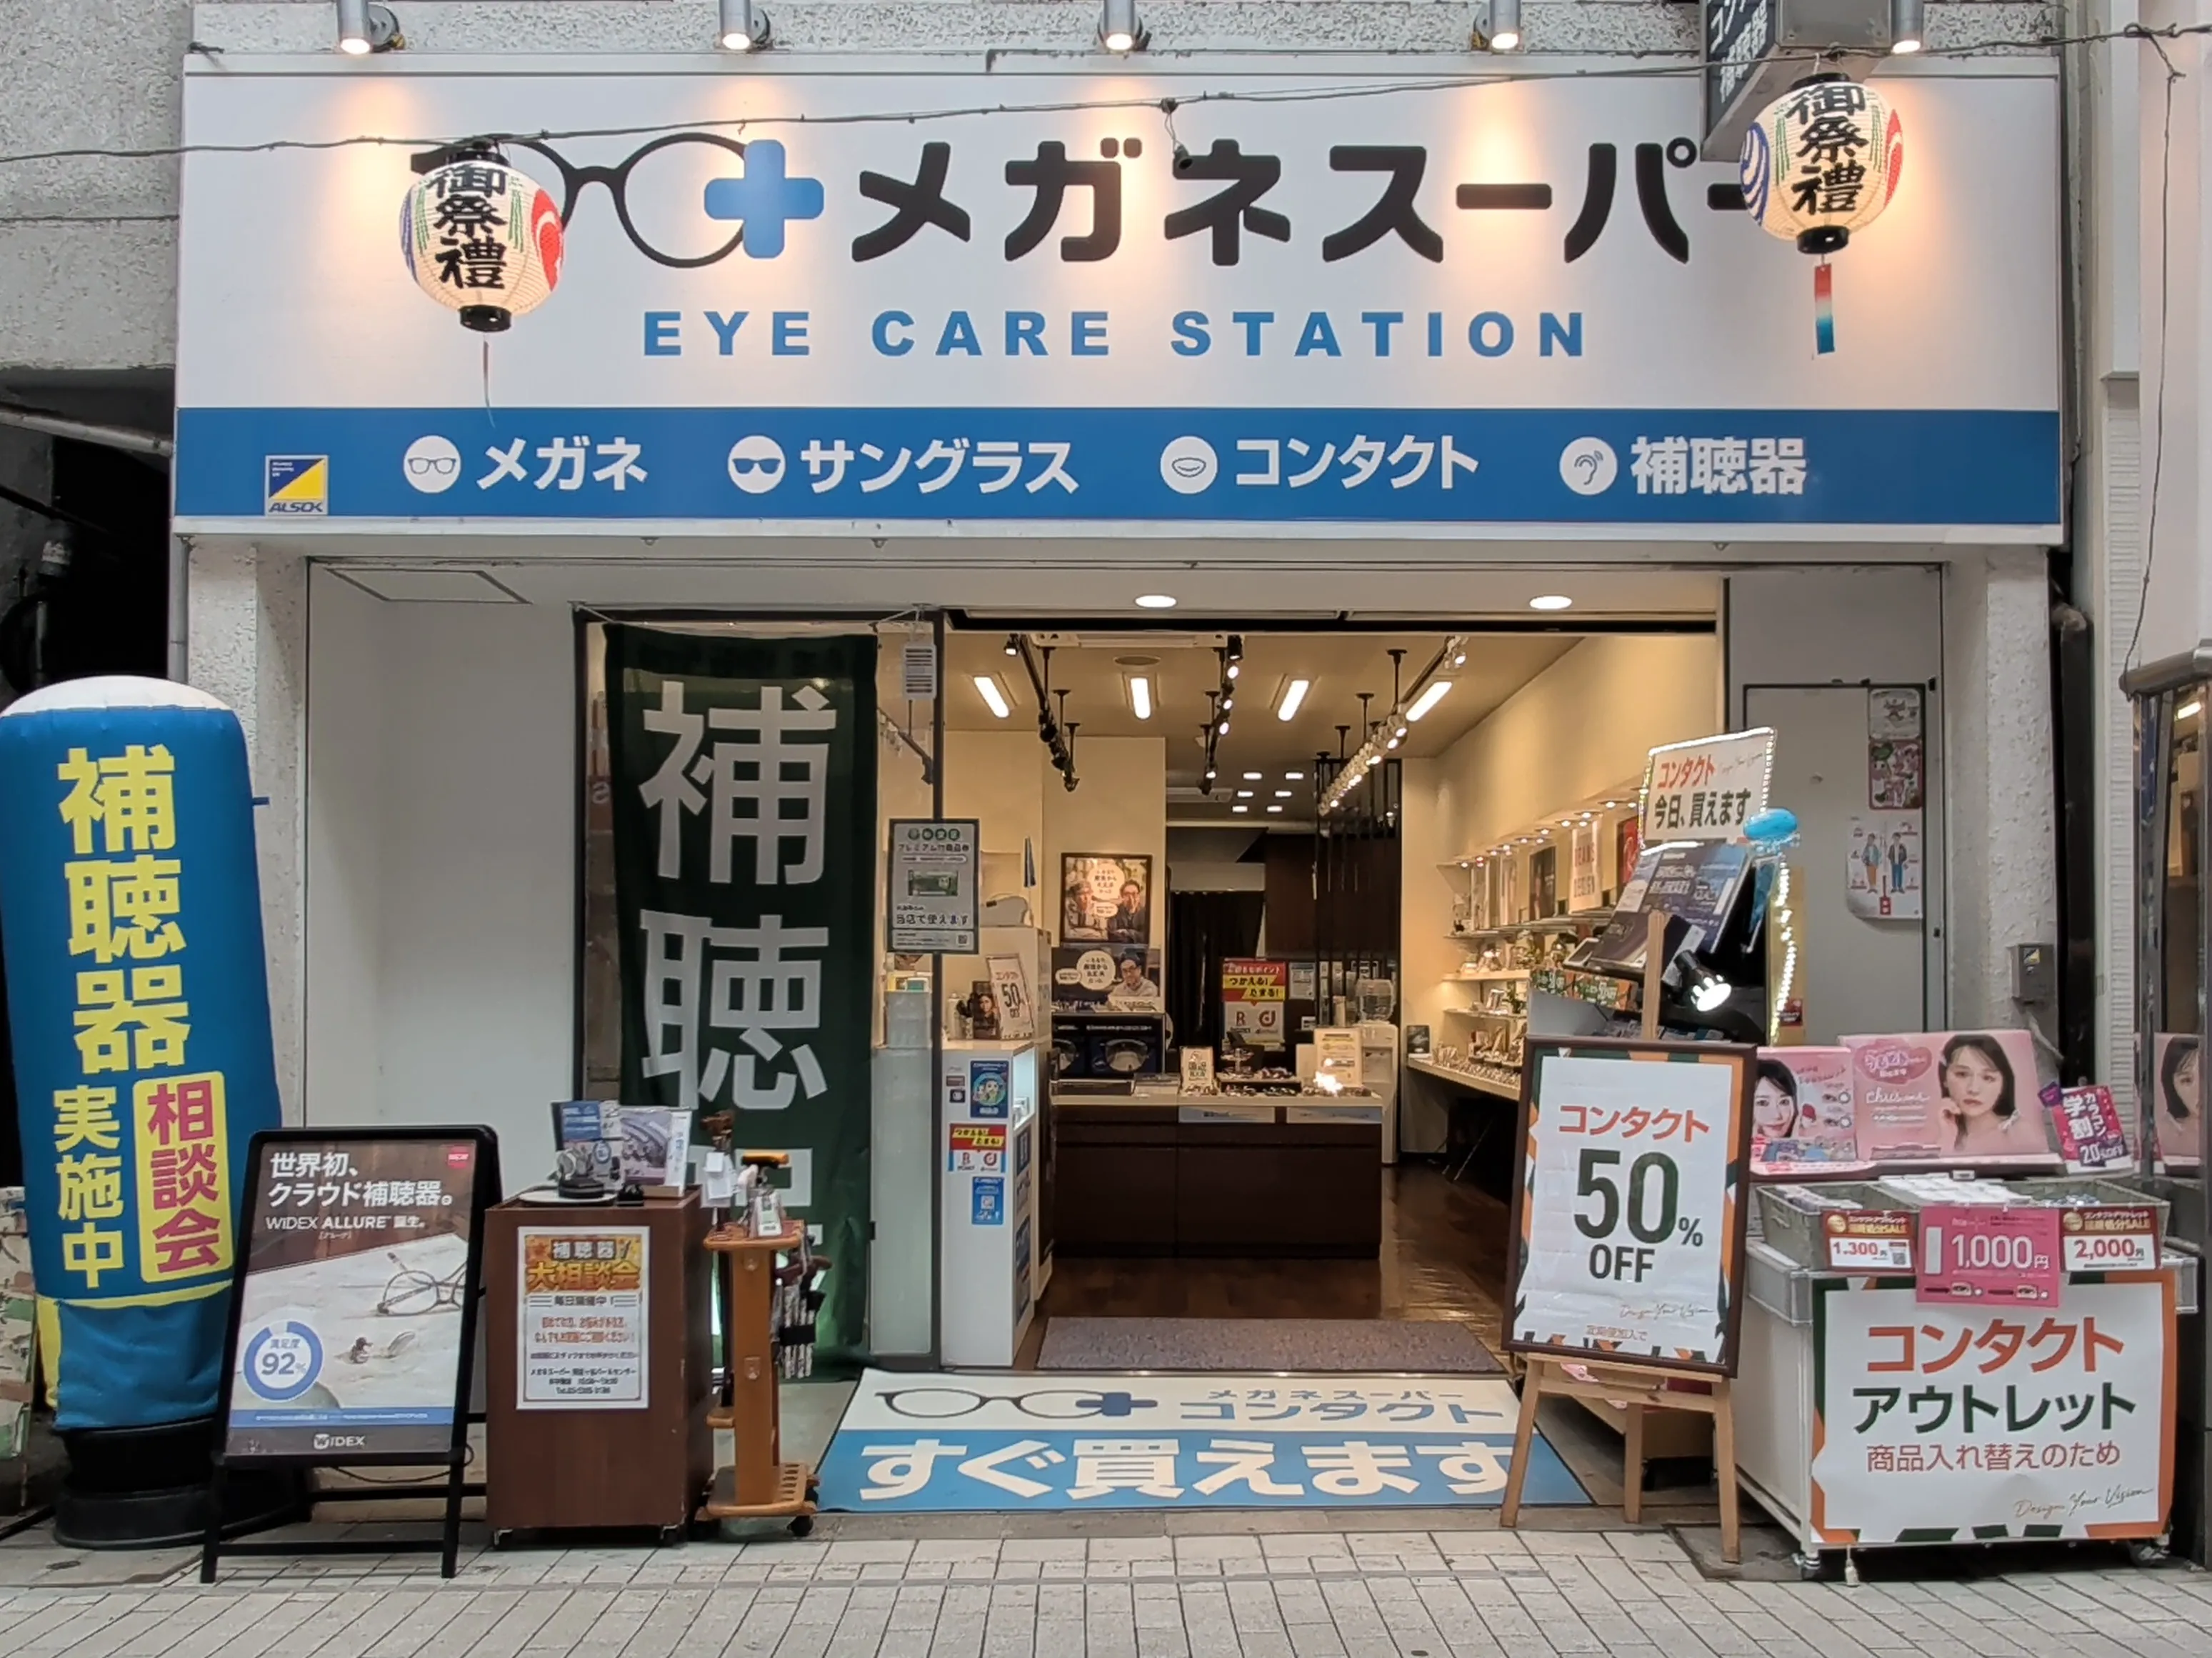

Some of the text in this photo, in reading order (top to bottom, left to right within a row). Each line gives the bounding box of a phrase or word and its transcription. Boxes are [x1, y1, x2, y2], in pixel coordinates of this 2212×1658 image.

[1786, 85, 1868, 215] 御祭禮
[429, 165, 507, 289] 御祭禮
[644, 311, 1583, 356] EYE CARE STATION
[476, 436, 648, 491] メガネ
[801, 437, 1079, 494] サングラス
[1236, 434, 1478, 490] コンタクト
[1630, 436, 1808, 494] 補聴器
[269, 501, 324, 513] ALSOK
[1657, 754, 1716, 788] コンタクト
[1654, 788, 1751, 829] 今日、買えます
[58, 744, 191, 1074] 補聴器
[1558, 1105, 1710, 1143] コンタクト
[2063, 1094, 2094, 1140] 学割
[2084, 1092, 2107, 1137] カラコン
[53, 1085, 124, 1289] 実施中
[147, 1080, 221, 1274] 相談会
[270, 1152, 358, 1178] 世界初、
[267, 1180, 454, 1207] クラウド補聴器。
[1574, 1149, 1703, 1247] 50%
[265, 1217, 318, 1230] WIDEX
[1589, 1244, 1655, 1283] OFF
[1866, 1317, 2125, 1374] コンタクト
[1180, 1402, 1503, 1424] コンタクト
[1208, 1389, 1465, 1400] メガネスーパー
[1852, 1382, 2136, 1434] アウトレット
[314, 1433, 366, 1449] WIDEX
[1866, 1441, 2121, 1472] 商品入れ替えのため
[859, 1438, 1512, 1500] すぐ買えます
[2013, 1484, 2154, 1519] Design Your Vision
